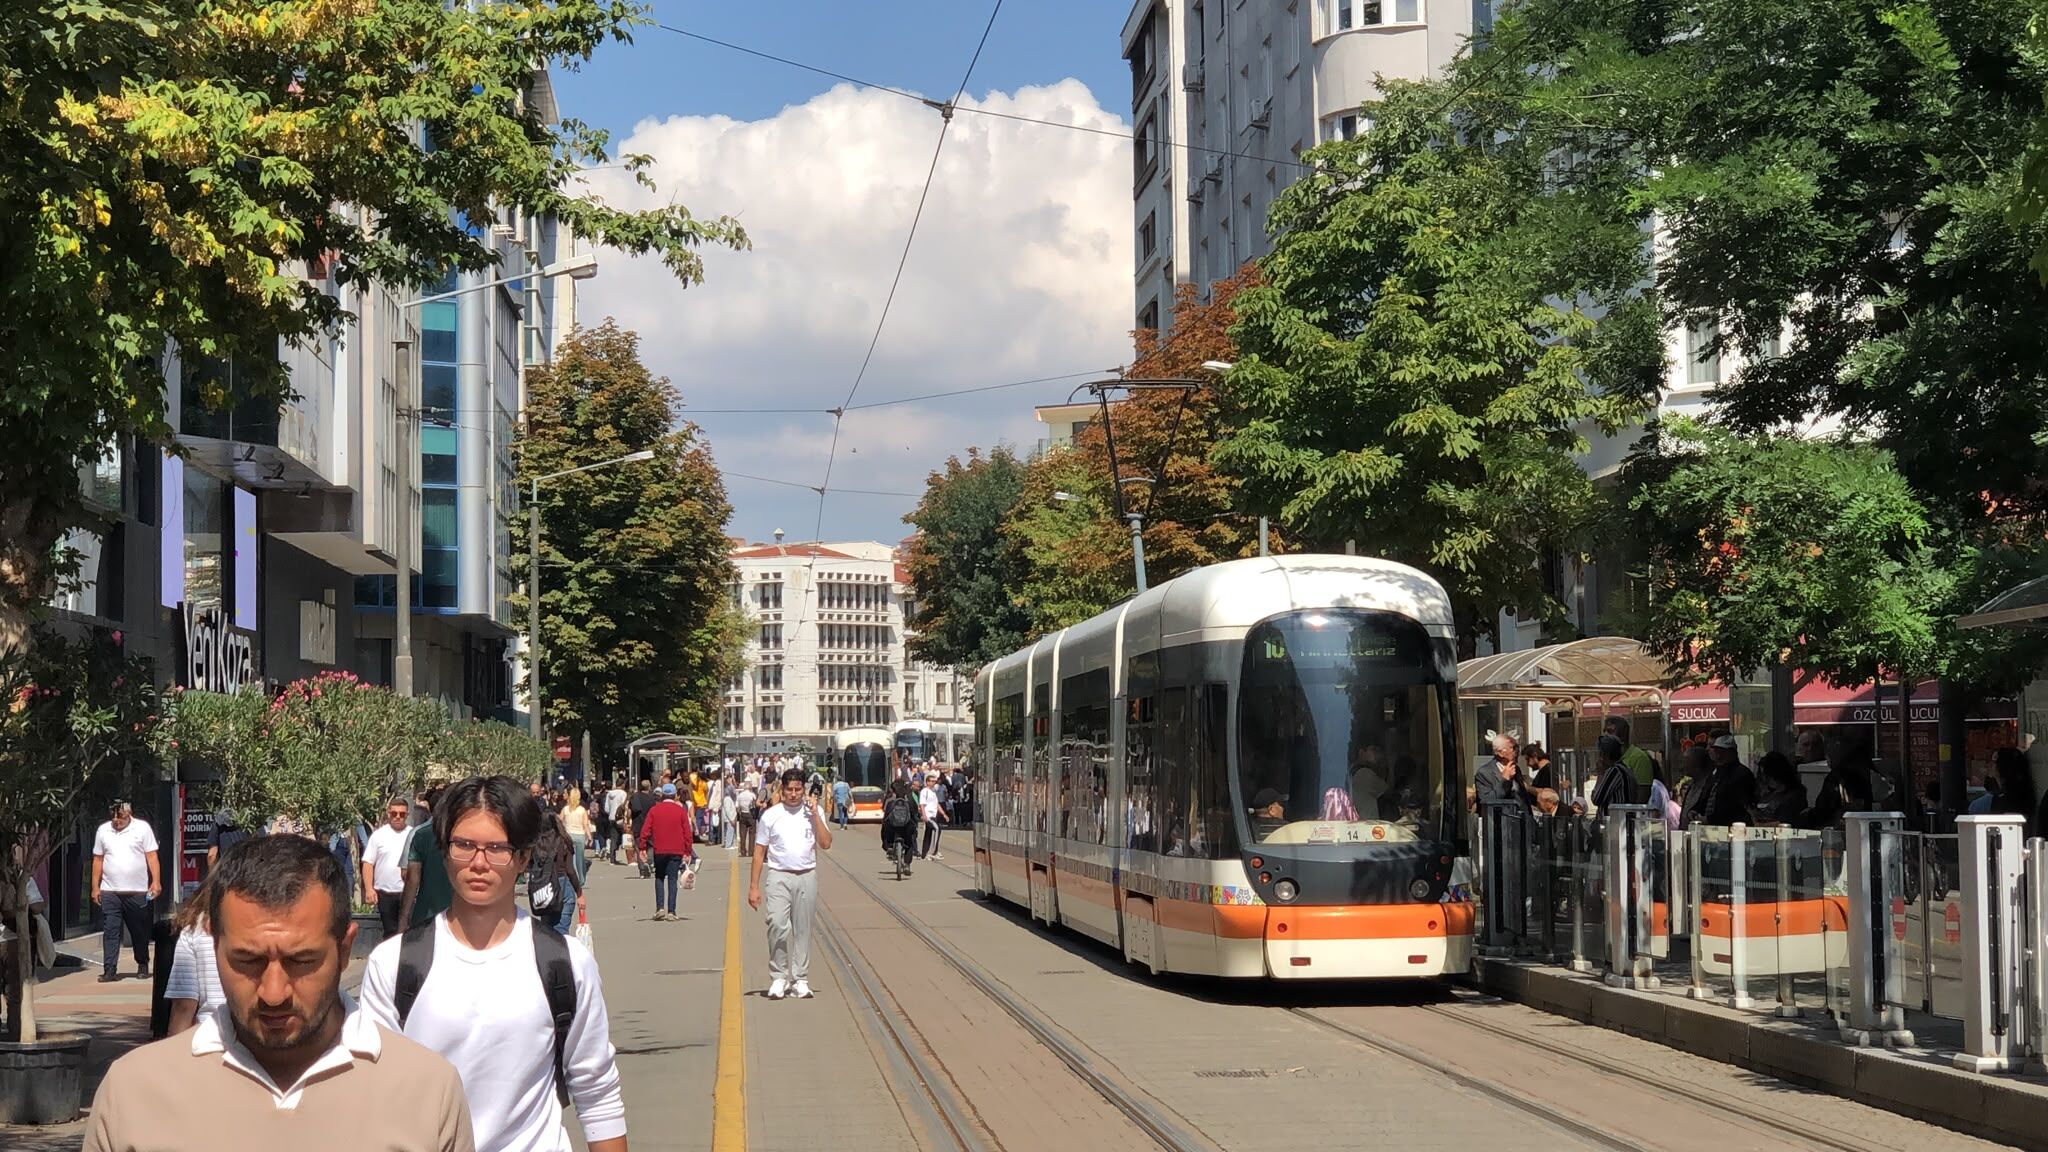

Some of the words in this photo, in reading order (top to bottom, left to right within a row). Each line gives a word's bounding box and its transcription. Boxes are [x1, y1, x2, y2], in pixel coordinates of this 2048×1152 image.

[1677, 707, 1717, 720] SUCUK
[1909, 707, 1940, 720] UCU
[184, 814, 204, 823] .000
[183, 823, 213, 833] NDİRİM
[1346, 830, 1359, 841] 14
[533, 881, 554, 906] NIKE
